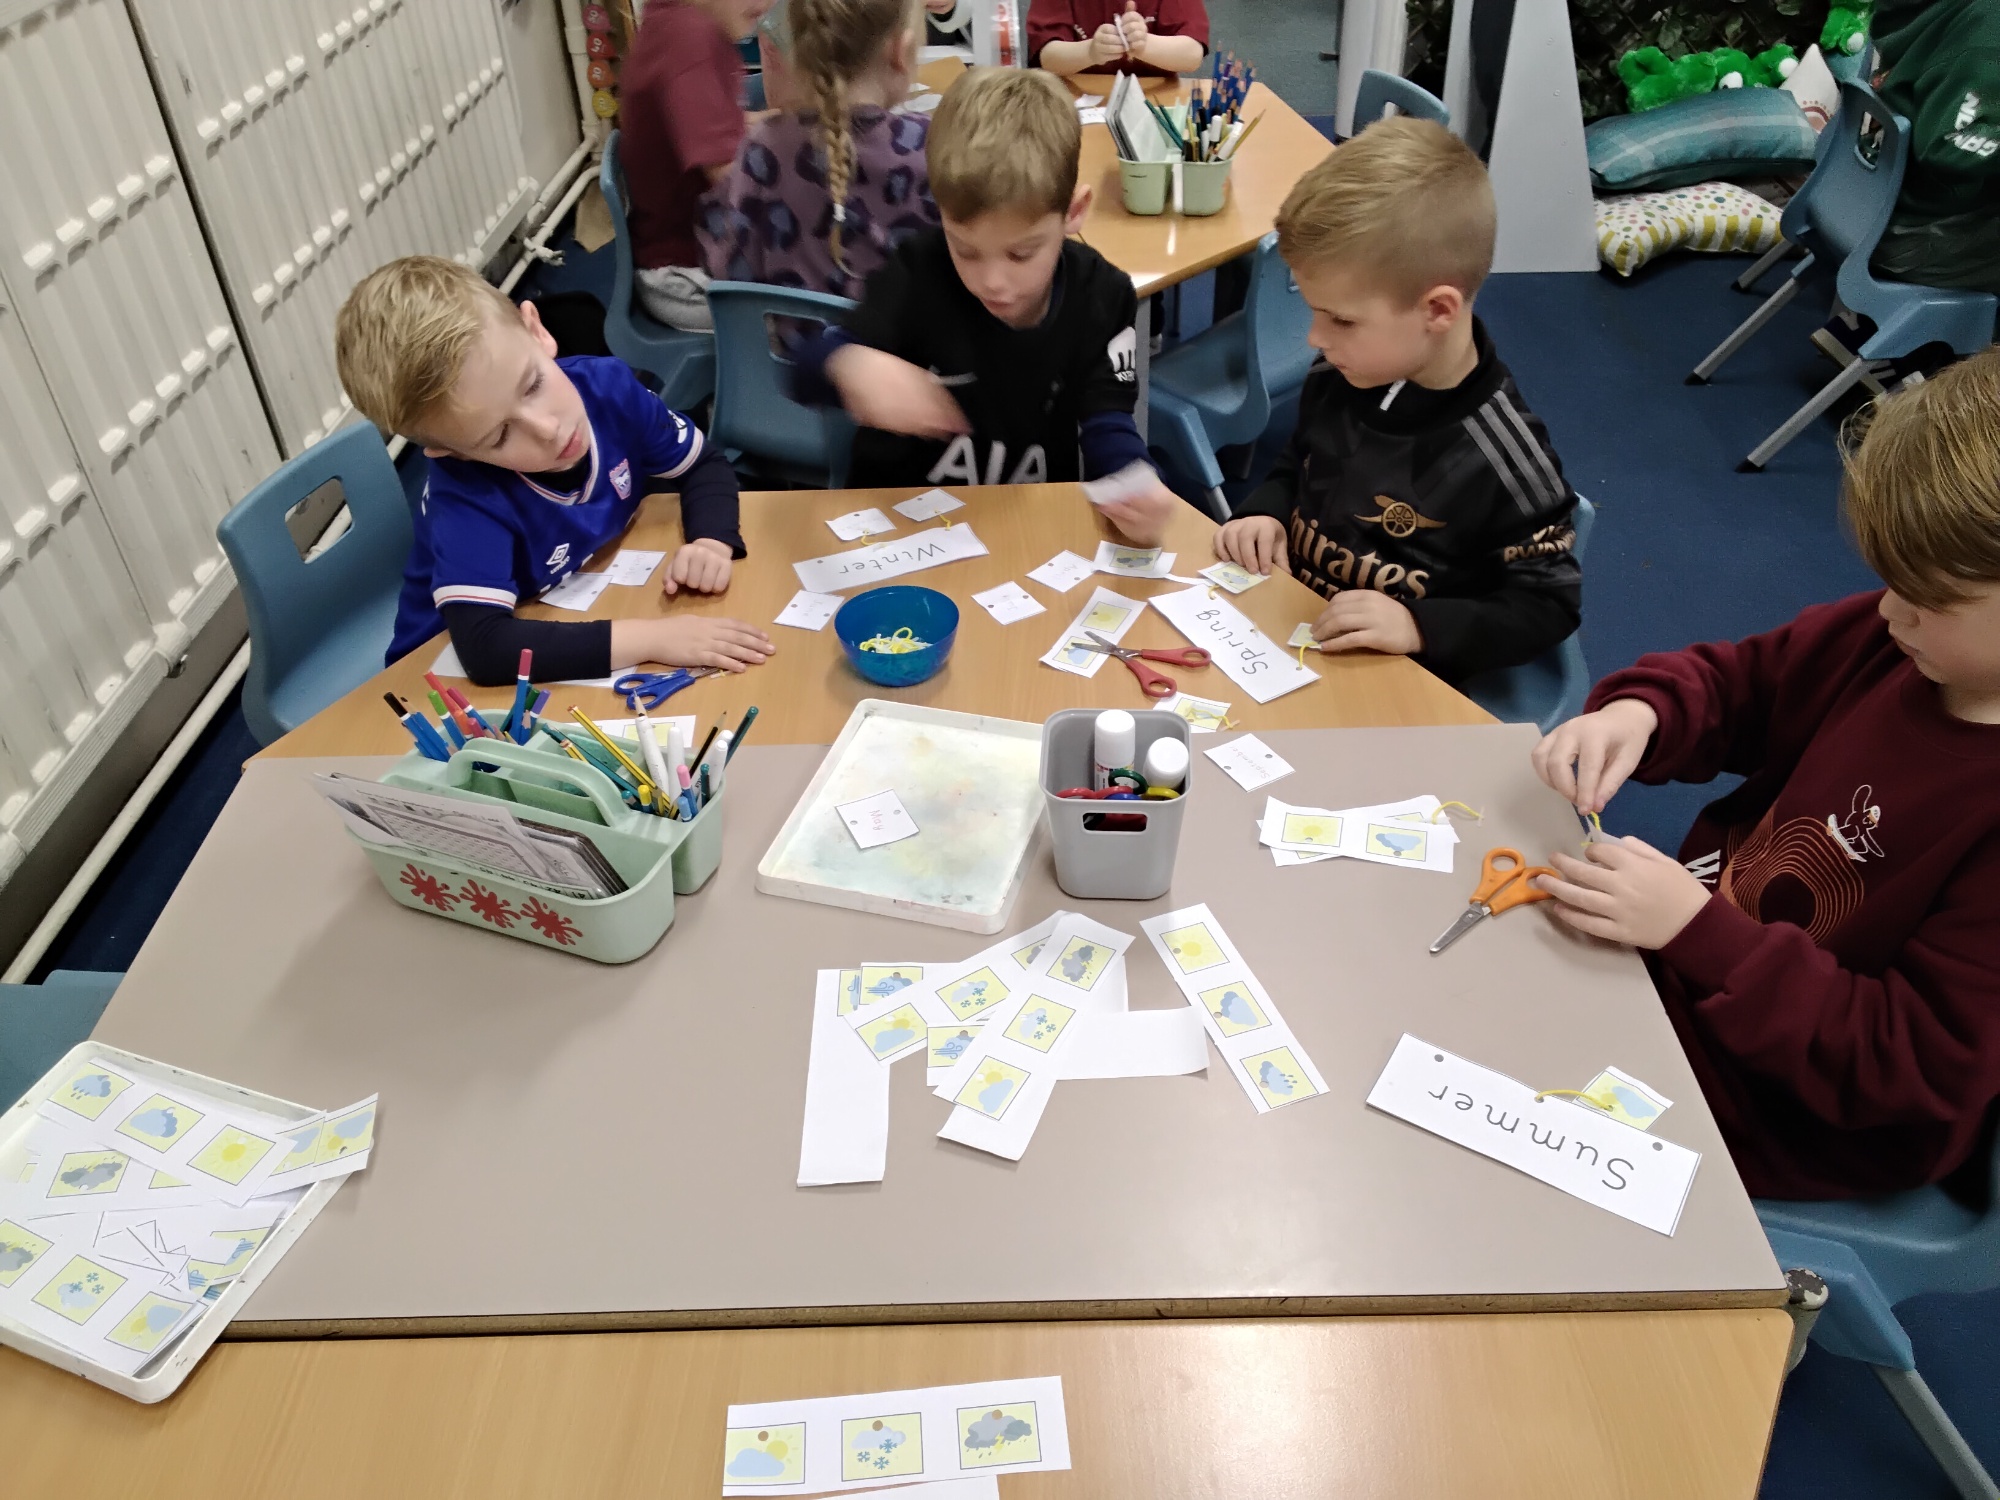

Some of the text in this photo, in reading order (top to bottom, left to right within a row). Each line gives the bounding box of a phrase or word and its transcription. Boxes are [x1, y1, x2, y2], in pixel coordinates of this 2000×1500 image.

[590, 37, 602, 53] 40
[926, 435, 1047, 486] AIA
[838, 542, 946, 574] Winter
[1291, 505, 1430, 600] mirates
[1195, 609, 1269, 675] Spring
[1228, 745, 1271, 779] September
[868, 809, 885, 831] May
[1427, 1085, 1635, 1191] Summer
